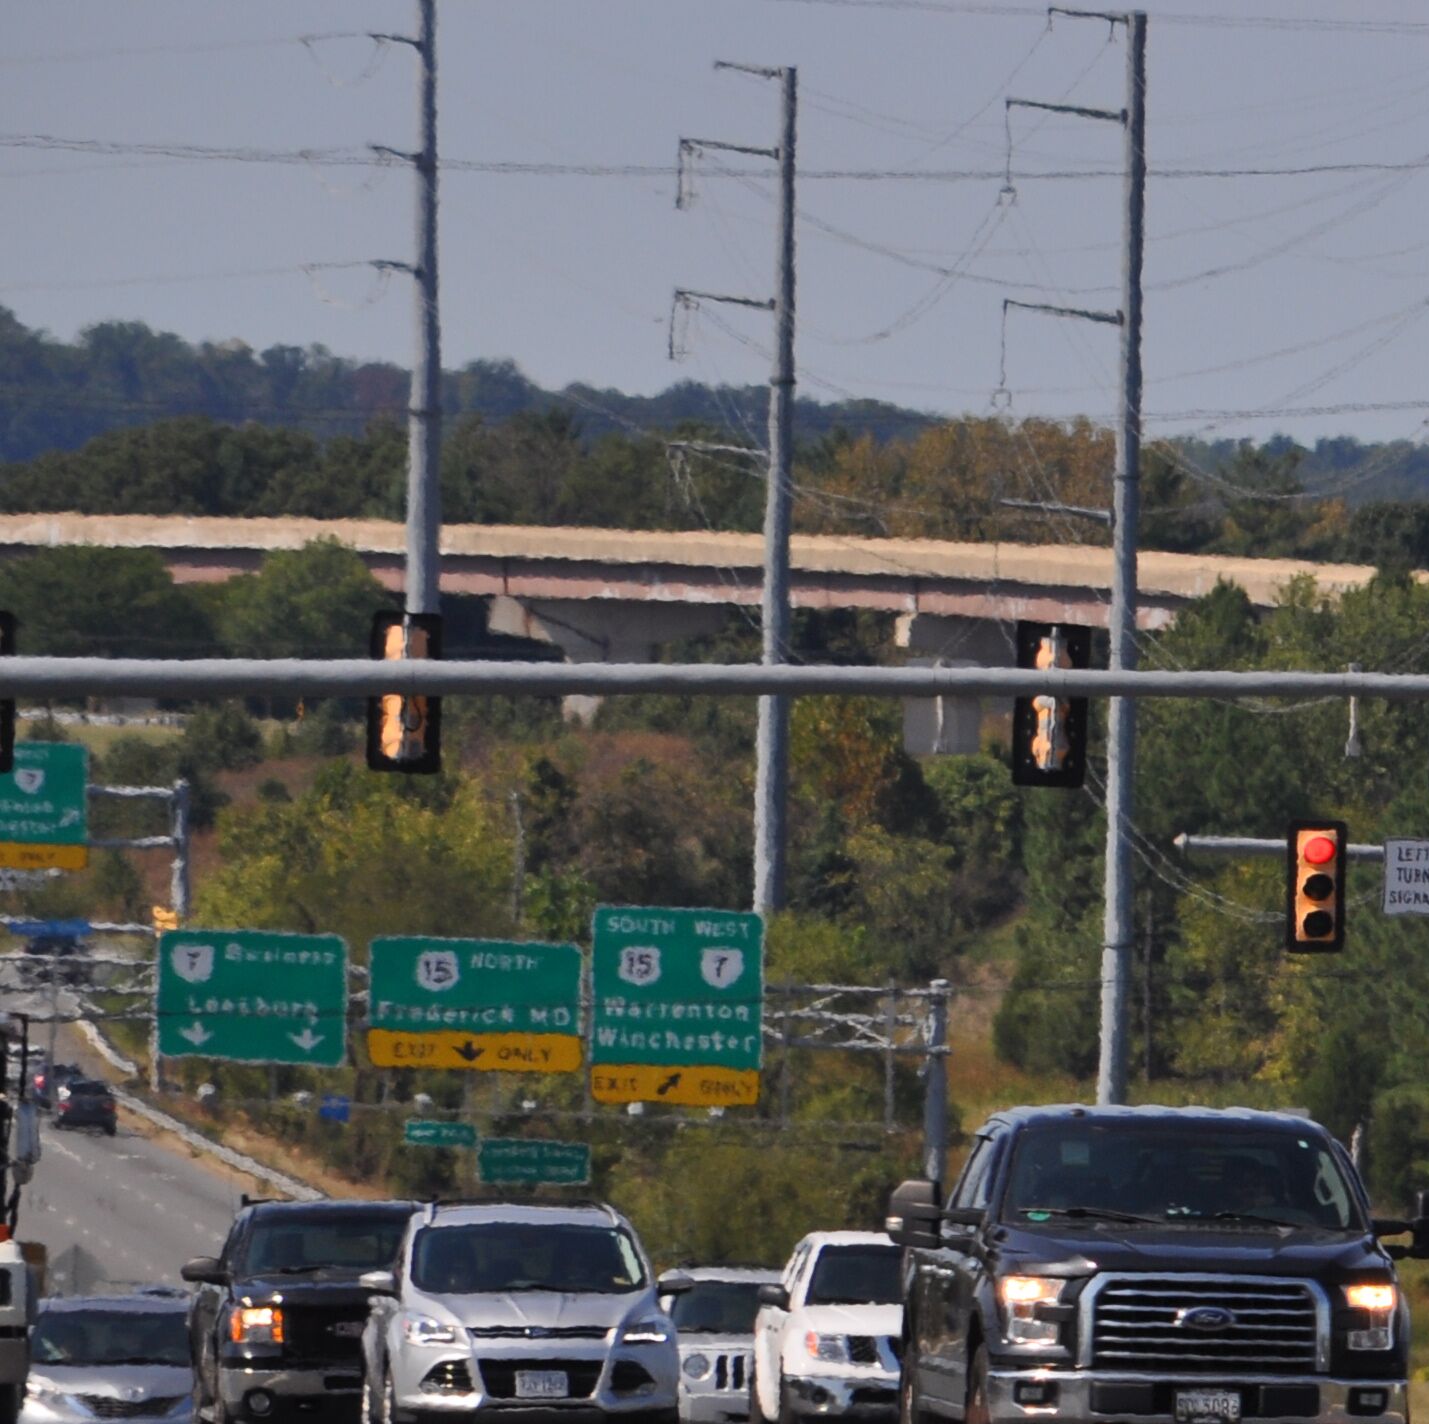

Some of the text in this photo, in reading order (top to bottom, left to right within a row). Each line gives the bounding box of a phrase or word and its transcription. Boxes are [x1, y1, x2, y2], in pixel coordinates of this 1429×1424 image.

[606, 915, 750, 939] SOUTH WEST
[186, 951, 200, 971] 7
[423, 952, 541, 984] 15 NORTH
[626, 951, 729, 979] 15 7
[377, 1001, 571, 1026] Frederick MD
[603, 996, 751, 1022] Warrenton
[597, 1026, 757, 1053] Winchester
[393, 1042, 550, 1063] EXIT ONLY
[593, 1075, 752, 1098] EXIT ONLY
